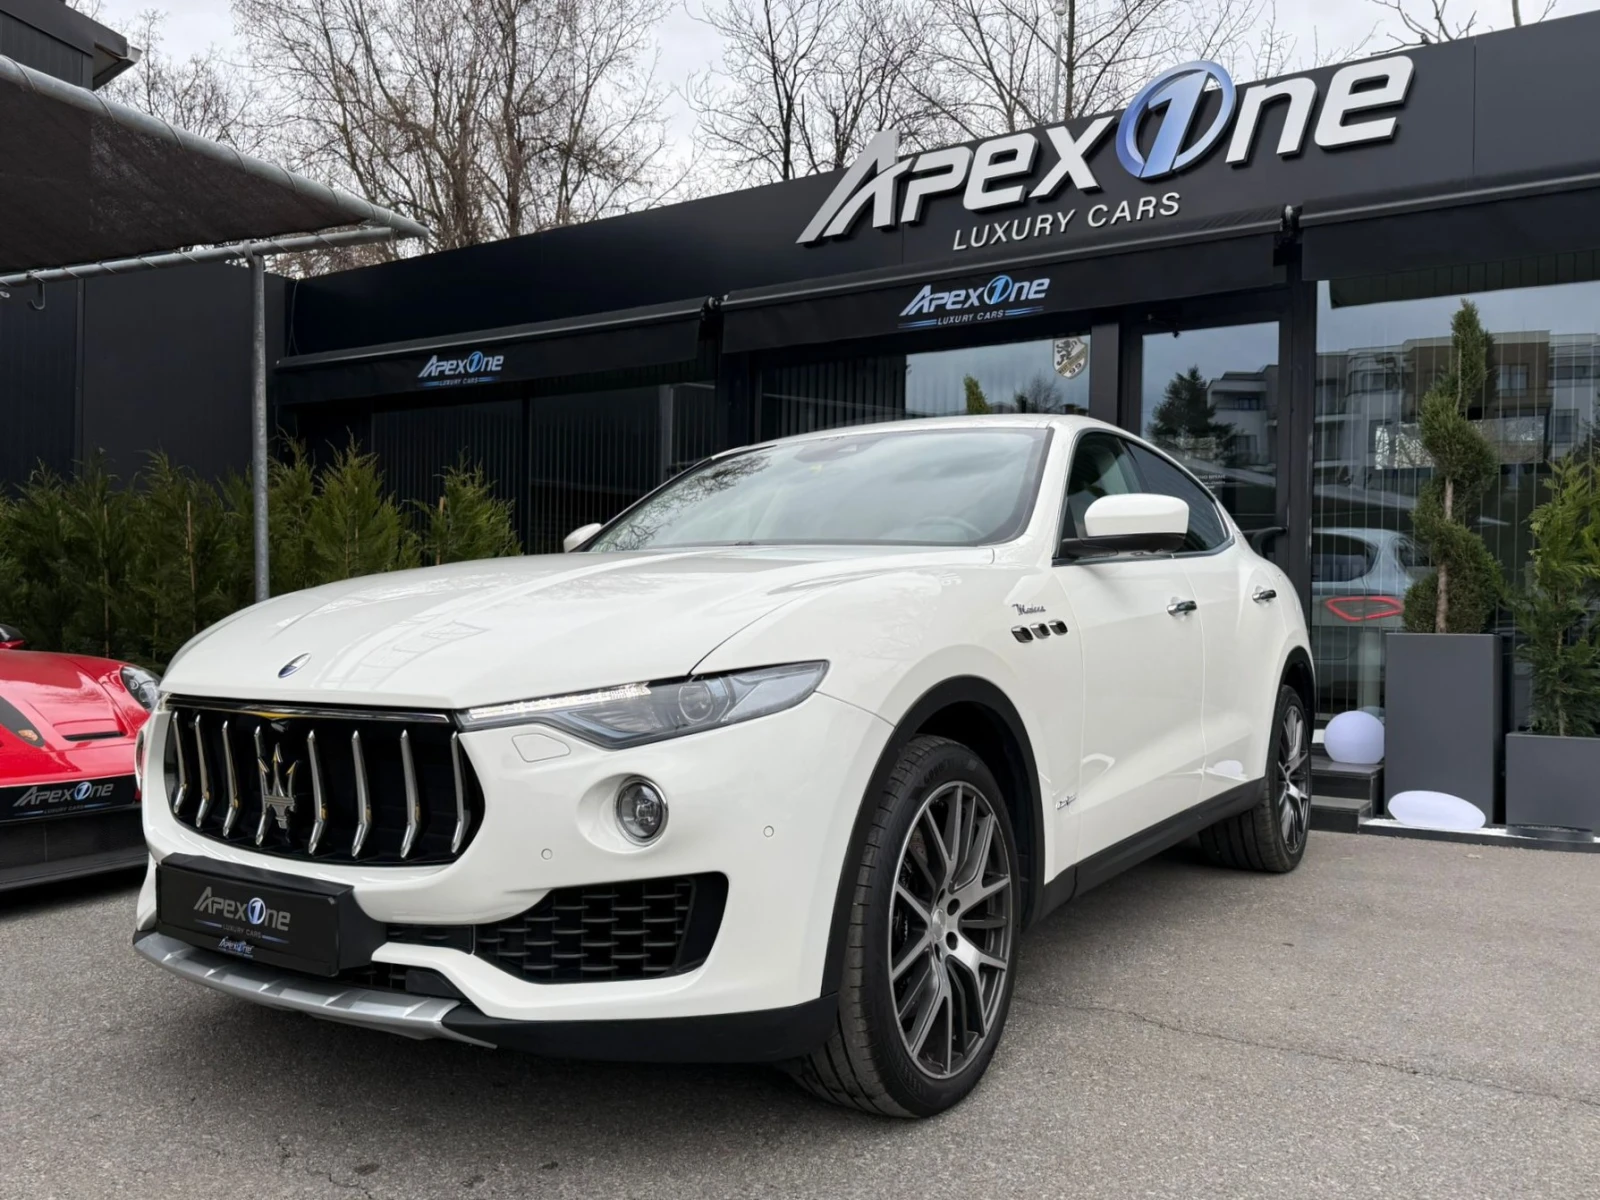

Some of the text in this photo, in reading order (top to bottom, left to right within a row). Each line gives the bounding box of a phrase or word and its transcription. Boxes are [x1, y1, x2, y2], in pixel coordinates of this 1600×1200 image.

[952, 191, 1181, 251] LUXURY CARS
[937, 309, 1004, 325] LUXURY CARS
